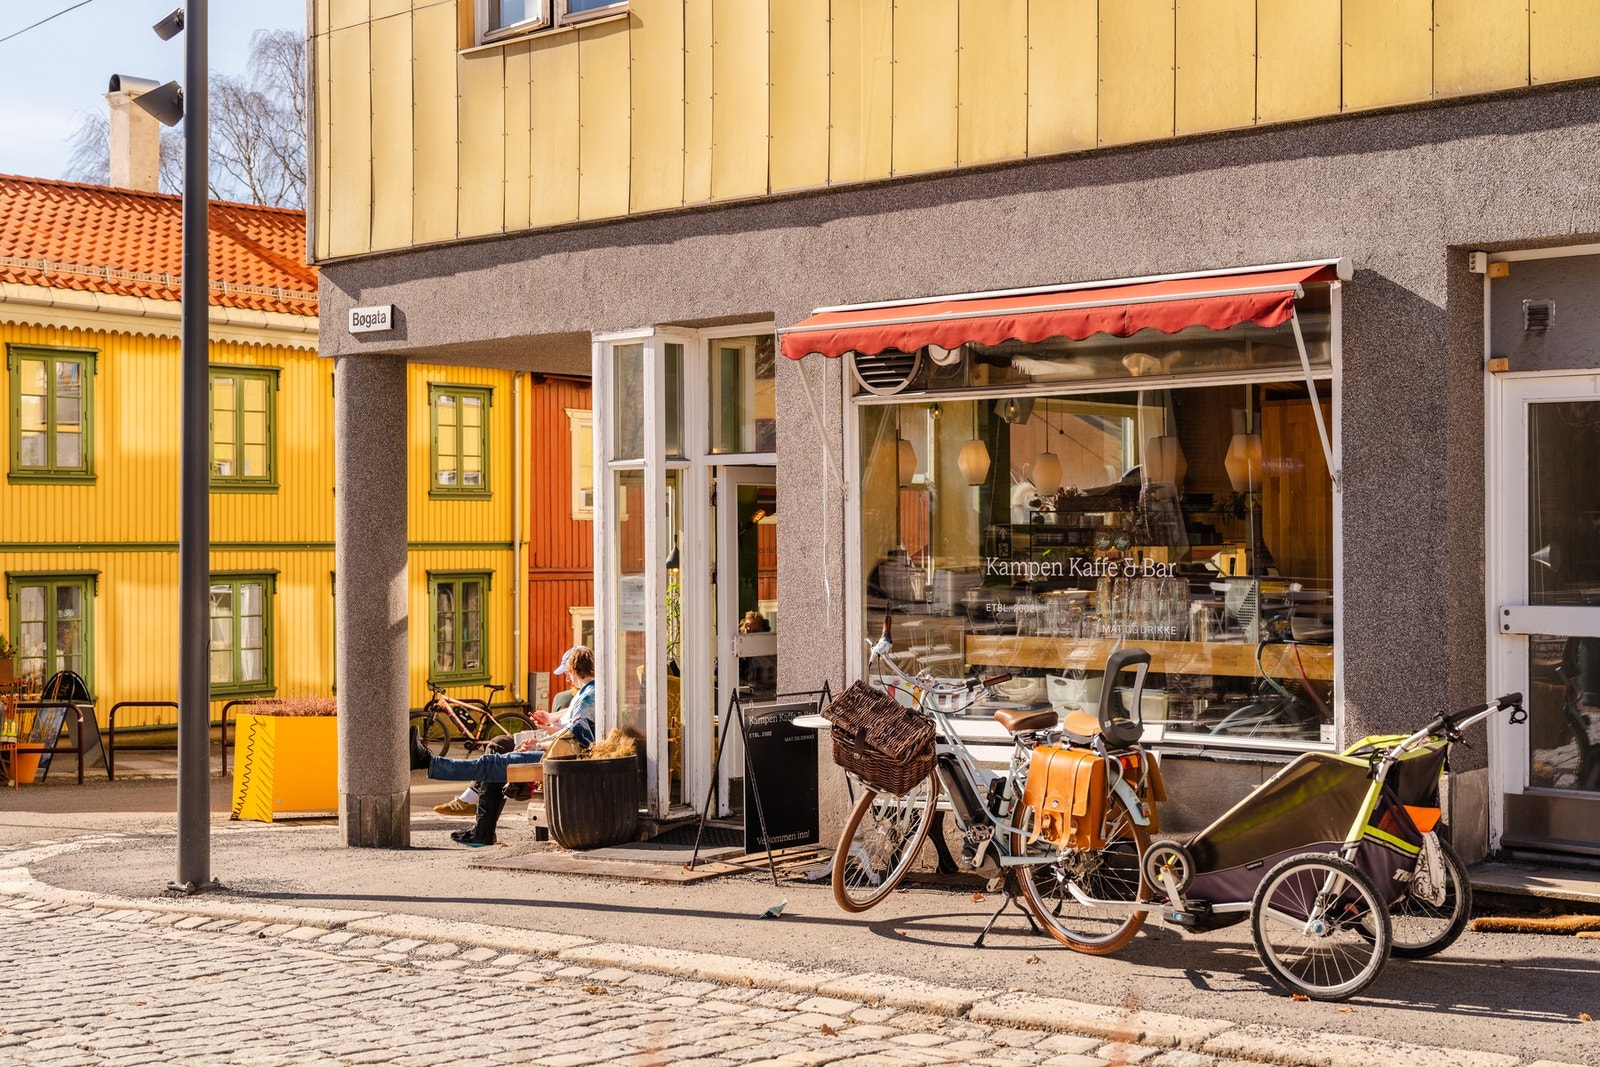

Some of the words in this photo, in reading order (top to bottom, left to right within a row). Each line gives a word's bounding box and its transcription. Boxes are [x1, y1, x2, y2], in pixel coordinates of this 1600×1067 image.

[352, 310, 387, 328] Bøgata
[986, 556, 1064, 580] Kampen
[1069, 557, 1118, 578] Kaffe
[1123, 557, 1139, 578] &
[1142, 557, 1177, 578] Bar
[985, 603, 1011, 613] ETBL.
[1013, 603, 1035, 613] 2002
[1102, 624, 1121, 634] MAT
[1125, 625, 1139, 634] OG
[1140, 625, 1177, 635] DRIKKE
[748, 714, 778, 726] Kampen
[756, 832, 797, 845] Vekommen
